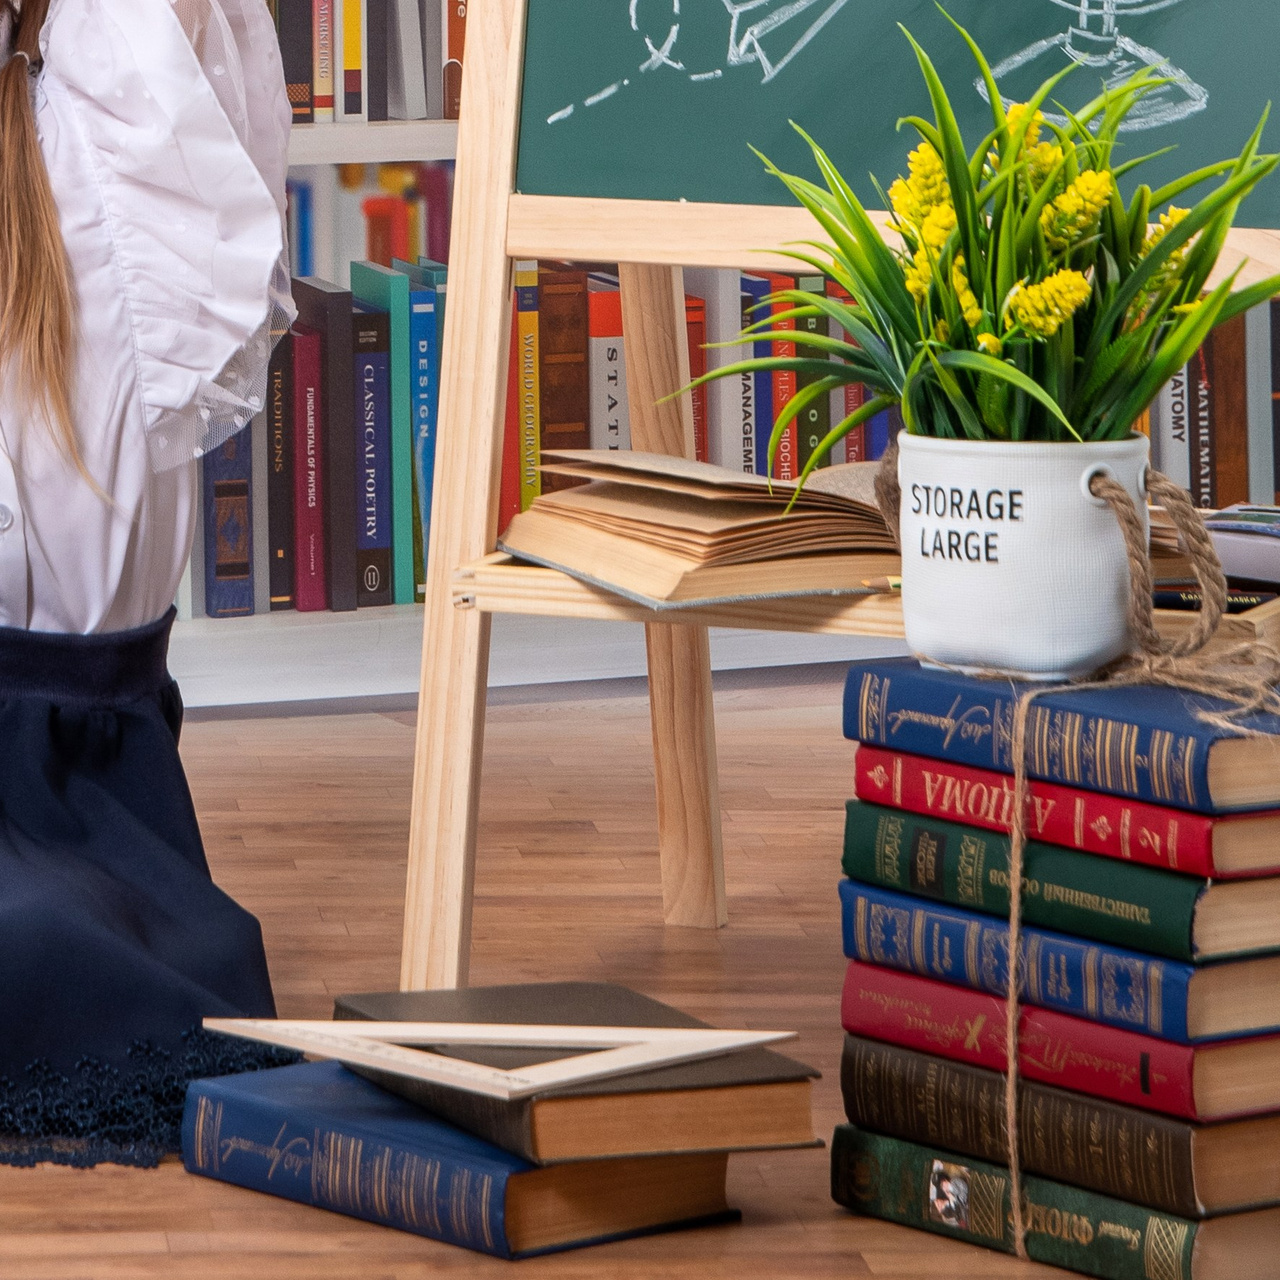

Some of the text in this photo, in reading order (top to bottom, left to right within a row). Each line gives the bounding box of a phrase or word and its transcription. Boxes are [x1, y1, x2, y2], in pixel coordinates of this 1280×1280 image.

[319, 4, 330, 79] MARKETING
[273, 368, 284, 473] TRADITIONS
[418, 339, 429, 439] DESIGN
[524, 332, 536, 488] WORLD GEOGRAPHY
[741, 372, 754, 474] MANAGEME
[1171, 372, 1186, 442] ATOMY
[306, 387, 316, 508] FUNDAMENTALS OF PHYSICS
[363, 364, 377, 540] CLASSICAL POETRY
[780, 428, 791, 480] BIOCHE
[1198, 380, 1211, 508] MATHEMATIC
[911, 482, 1024, 521] STORAGE
[920, 526, 1000, 562] LARGE
